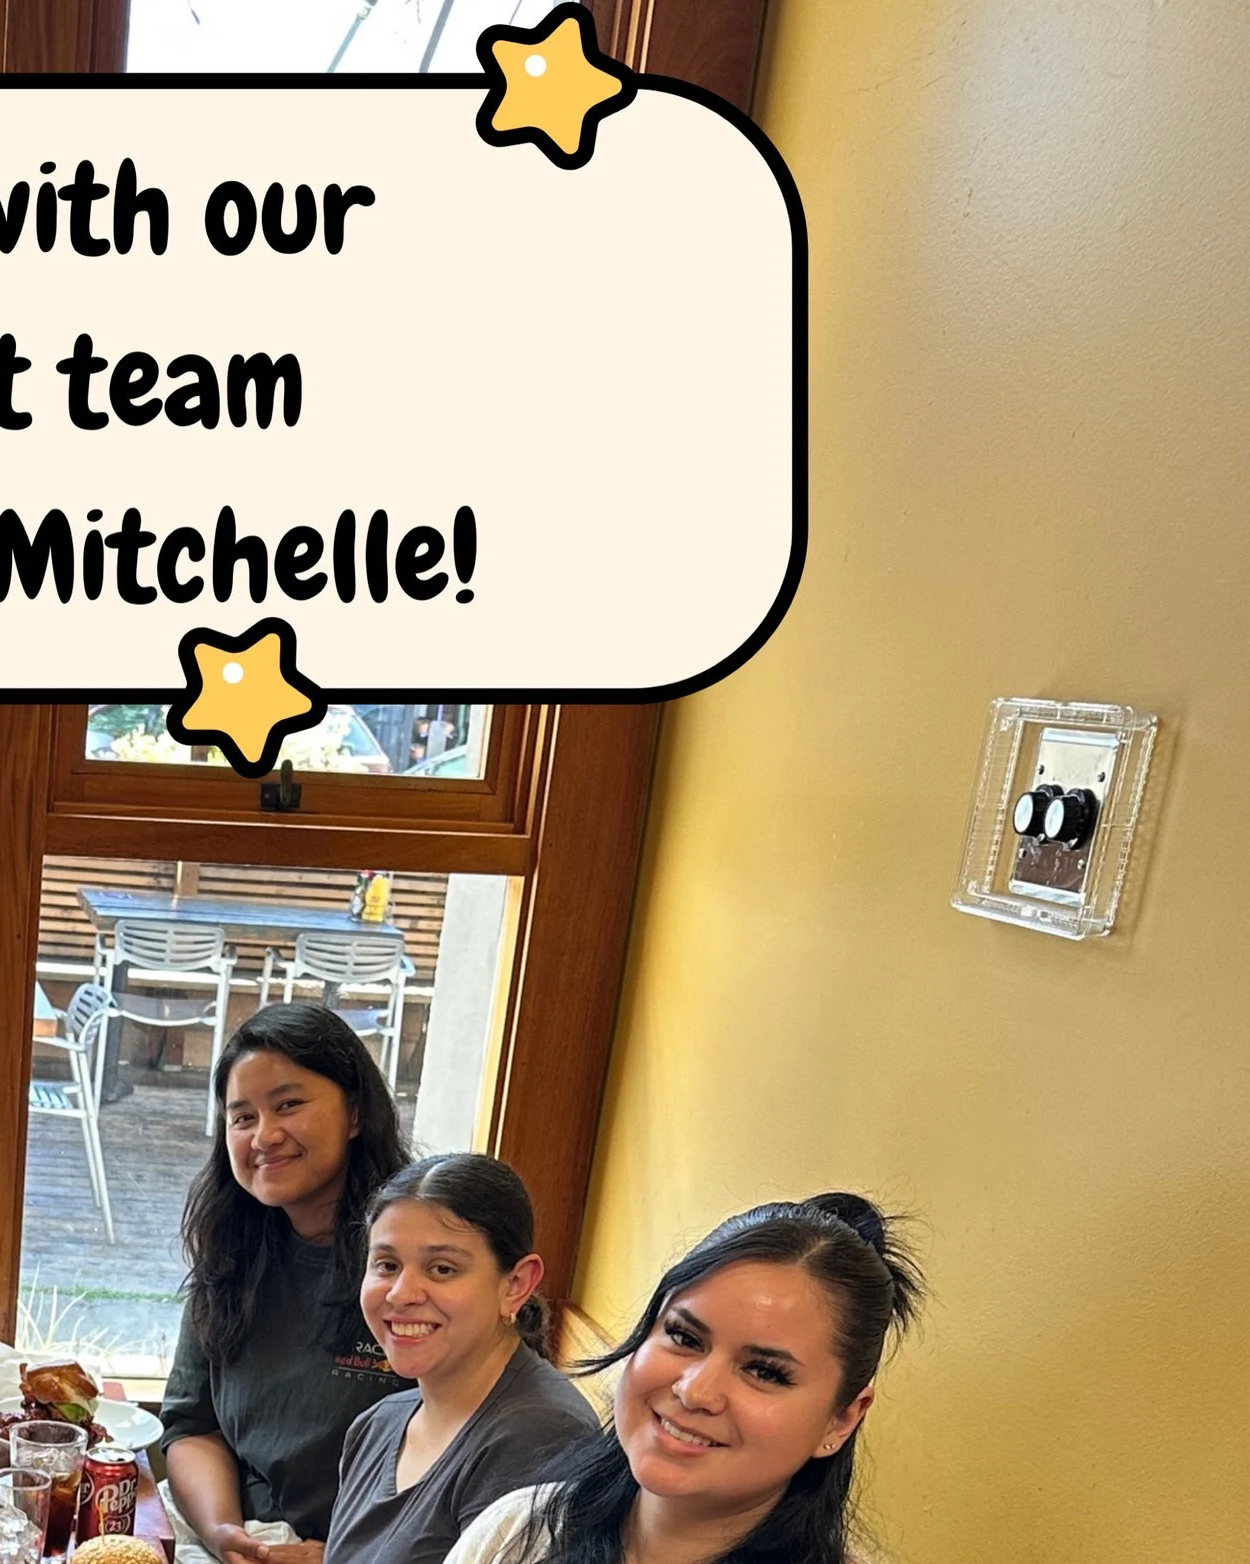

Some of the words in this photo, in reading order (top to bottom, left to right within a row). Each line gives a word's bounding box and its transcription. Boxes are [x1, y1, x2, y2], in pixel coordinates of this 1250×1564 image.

[355, 1341, 385, 1356] RAC
[334, 1355, 353, 1366] Red
[354, 1356, 371, 1368] Bull
[331, 1368, 399, 1387] RACING
[119, 1479, 136, 1497] Dr
[95, 1484, 136, 1513] Pepp
[109, 1521, 122, 1532] 23
